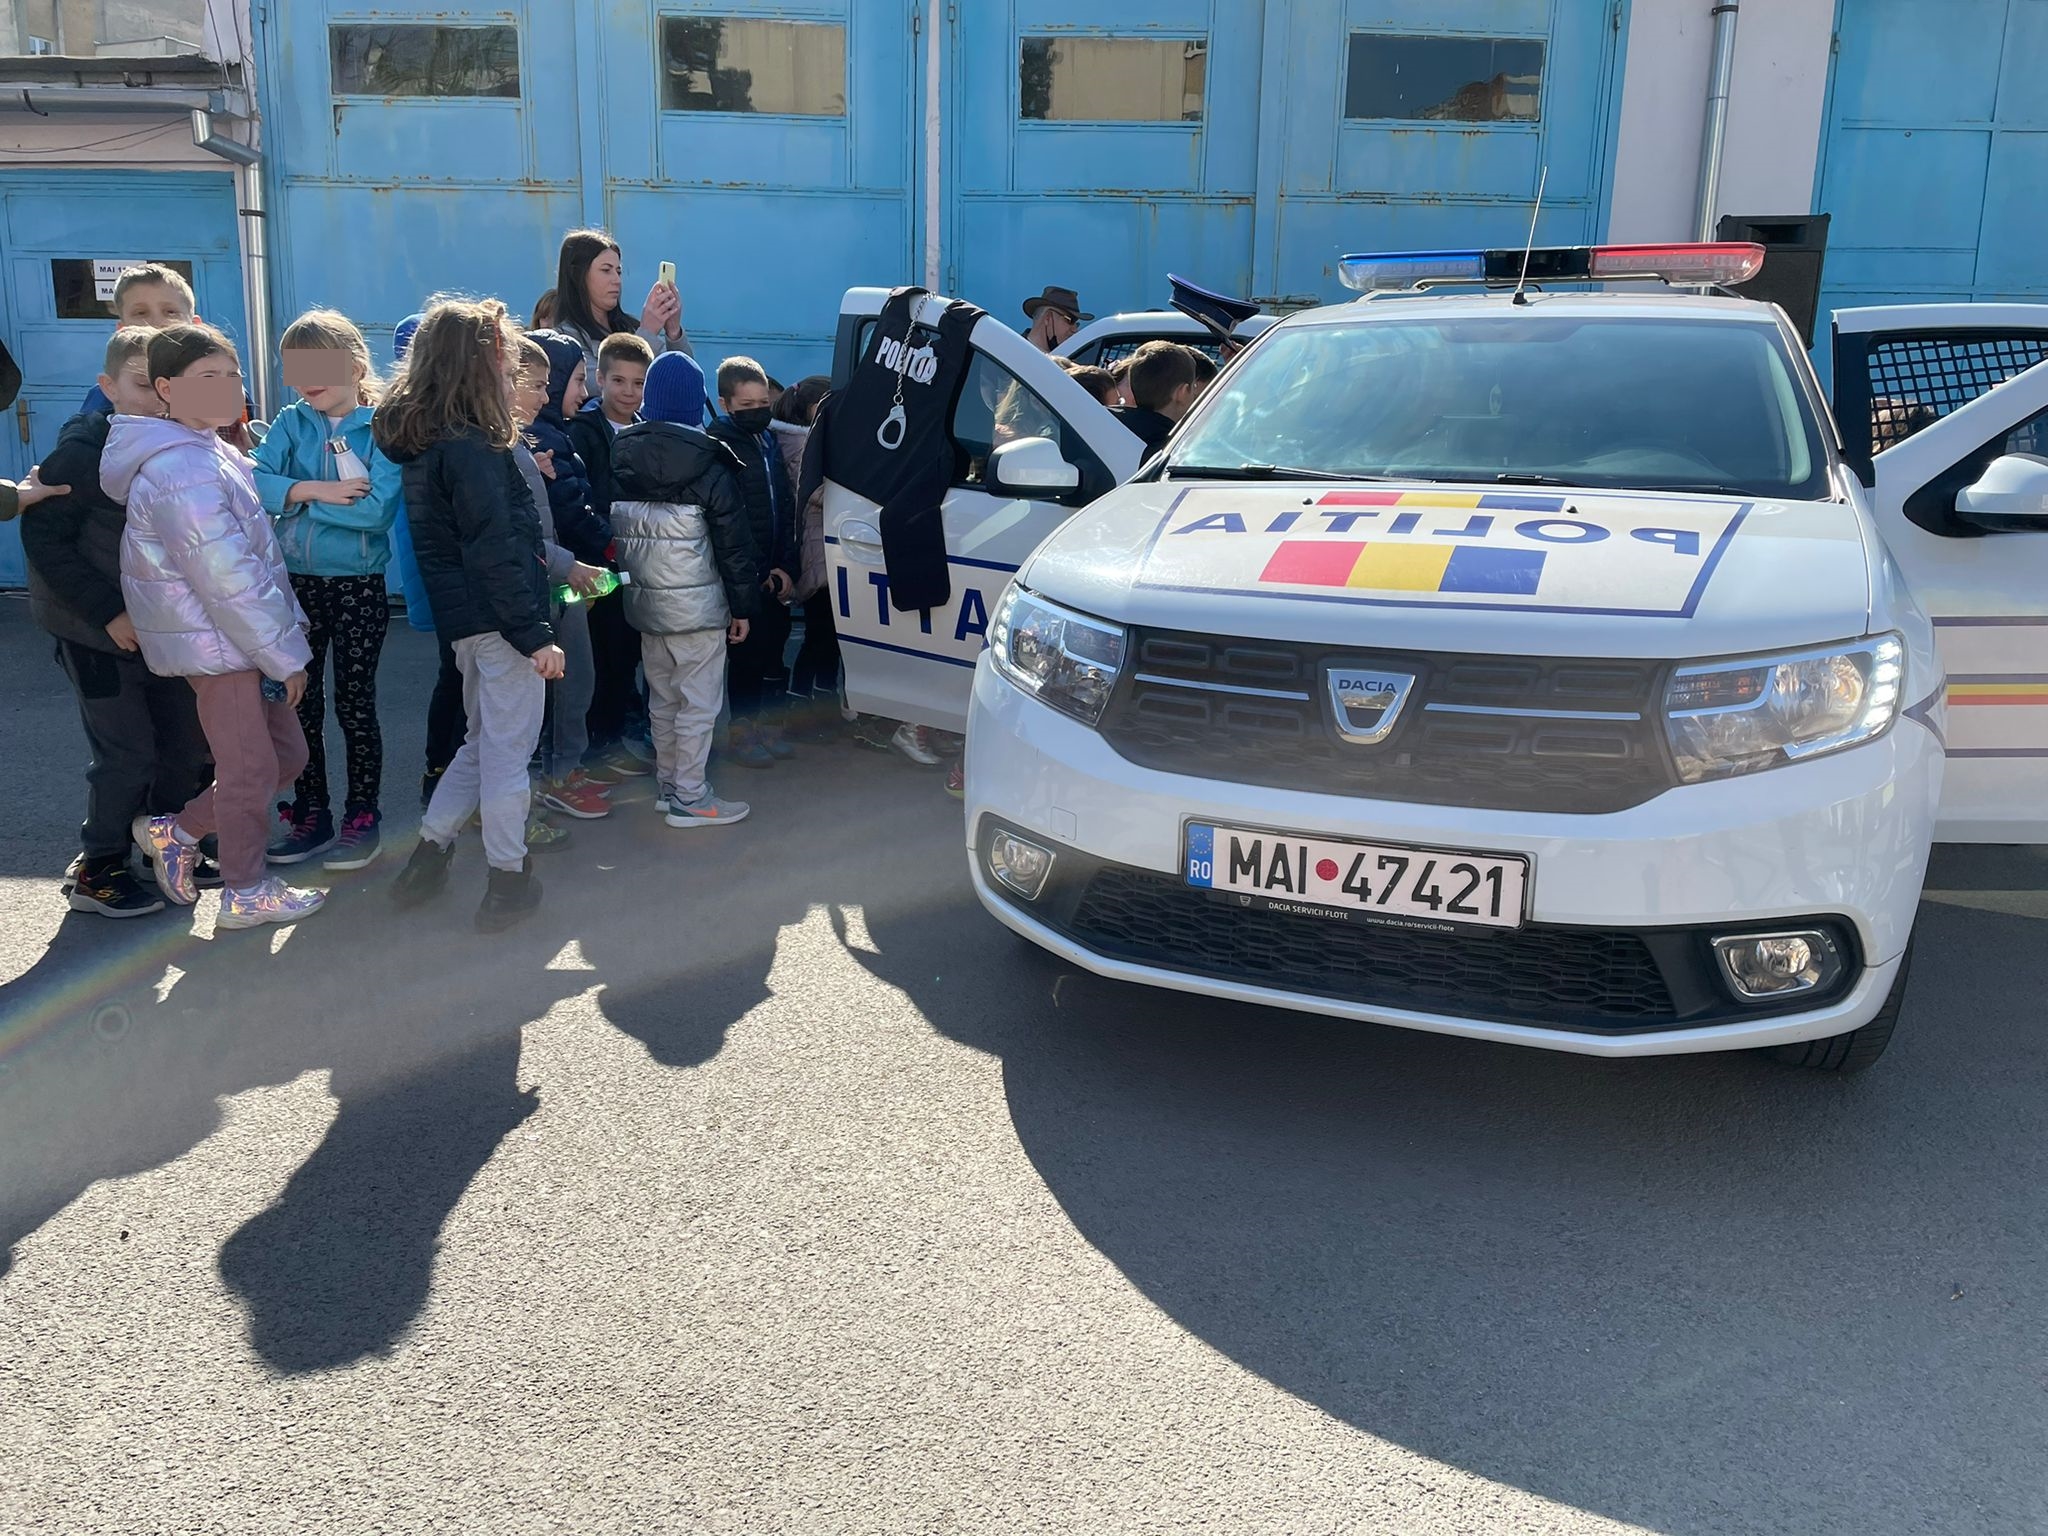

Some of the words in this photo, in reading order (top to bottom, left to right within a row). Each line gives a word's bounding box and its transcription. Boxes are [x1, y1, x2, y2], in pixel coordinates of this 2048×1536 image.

[1338, 679, 1397, 693] DACIA
[1190, 859, 1211, 880] RO
[1229, 836, 1308, 895] MAI
[1341, 852, 1503, 918] 47421
[1268, 902, 1291, 912] DACIA
[1292, 905, 1324, 917] SERVICII
[1325, 909, 1349, 920] FLOTE
